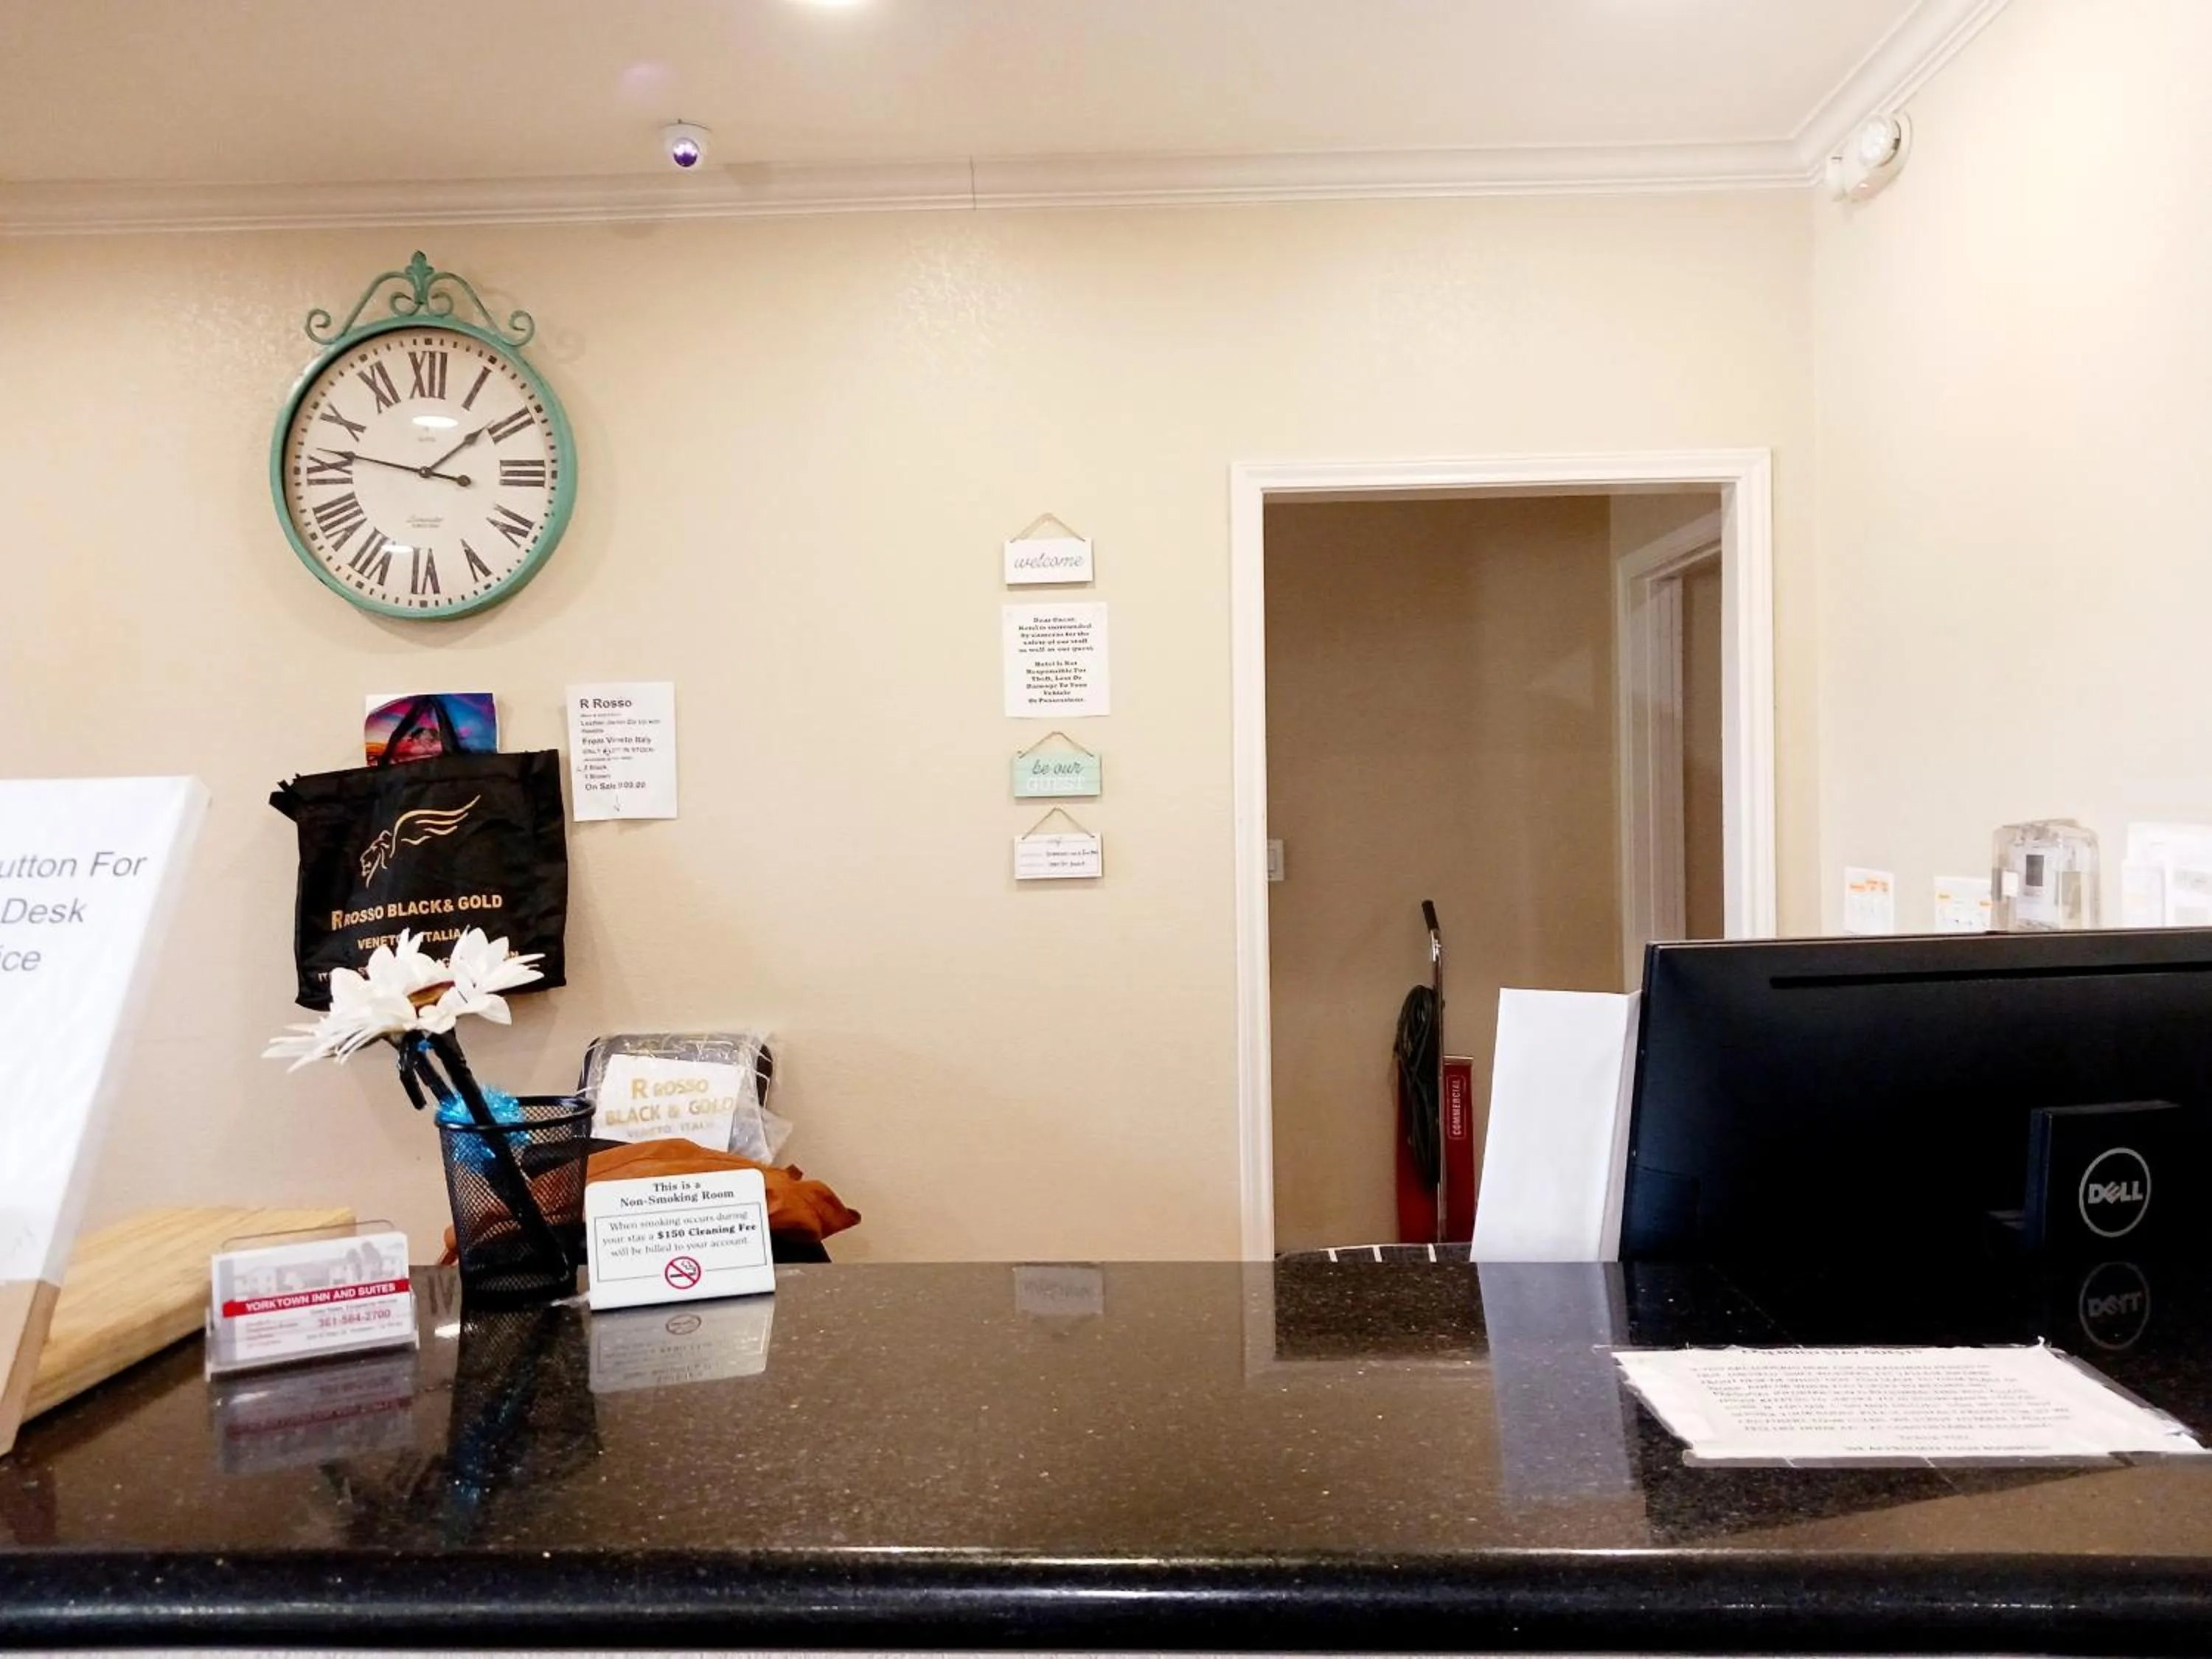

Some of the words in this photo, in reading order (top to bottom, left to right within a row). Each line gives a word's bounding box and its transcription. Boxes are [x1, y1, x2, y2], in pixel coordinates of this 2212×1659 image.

[408, 351, 448, 399] XII
[356, 361, 401, 414] XI
[320, 403, 366, 442] X
[1014, 552, 1085, 568] welcome
[580, 698, 589, 709] R
[593, 698, 632, 709] Rosso
[1032, 759, 1051, 775] be
[1053, 761, 1085, 775] our
[89, 851, 148, 877] For
[0, 897, 88, 924] Desk
[458, 894, 503, 909] GOLD
[419, 928, 462, 943] TALIA
[632, 1079, 648, 1099] R
[605, 1105, 661, 1125] BLACK
[1452, 1079, 1462, 1135] COMMERCIAL
[653, 1182, 678, 1192] This
[681, 1180, 691, 1189] is
[2087, 1180, 2143, 1204] DELL
[620, 1193, 699, 1207] Non-Smoking
[701, 1190, 734, 1200] Room
[609, 1221, 638, 1231] When
[640, 1218, 681, 1230] smoking
[683, 1214, 714, 1224] occurs
[716, 1211, 748, 1222] during
[602, 1235, 627, 1246] your
[627, 1233, 647, 1244] stay
[657, 1229, 686, 1240] $150
[688, 1225, 736, 1237] Cleaning
[738, 1223, 757, 1232] Fee
[611, 1248, 629, 1256] will
[632, 1246, 643, 1255] be
[644, 1243, 672, 1254] billed
[674, 1243, 684, 1251] to
[686, 1241, 709, 1252] your
[245, 1295, 310, 1312] YORKTOWN
[311, 1293, 330, 1302] INN
[333, 1287, 355, 1299] AND
[358, 1282, 396, 1295] SUITES
